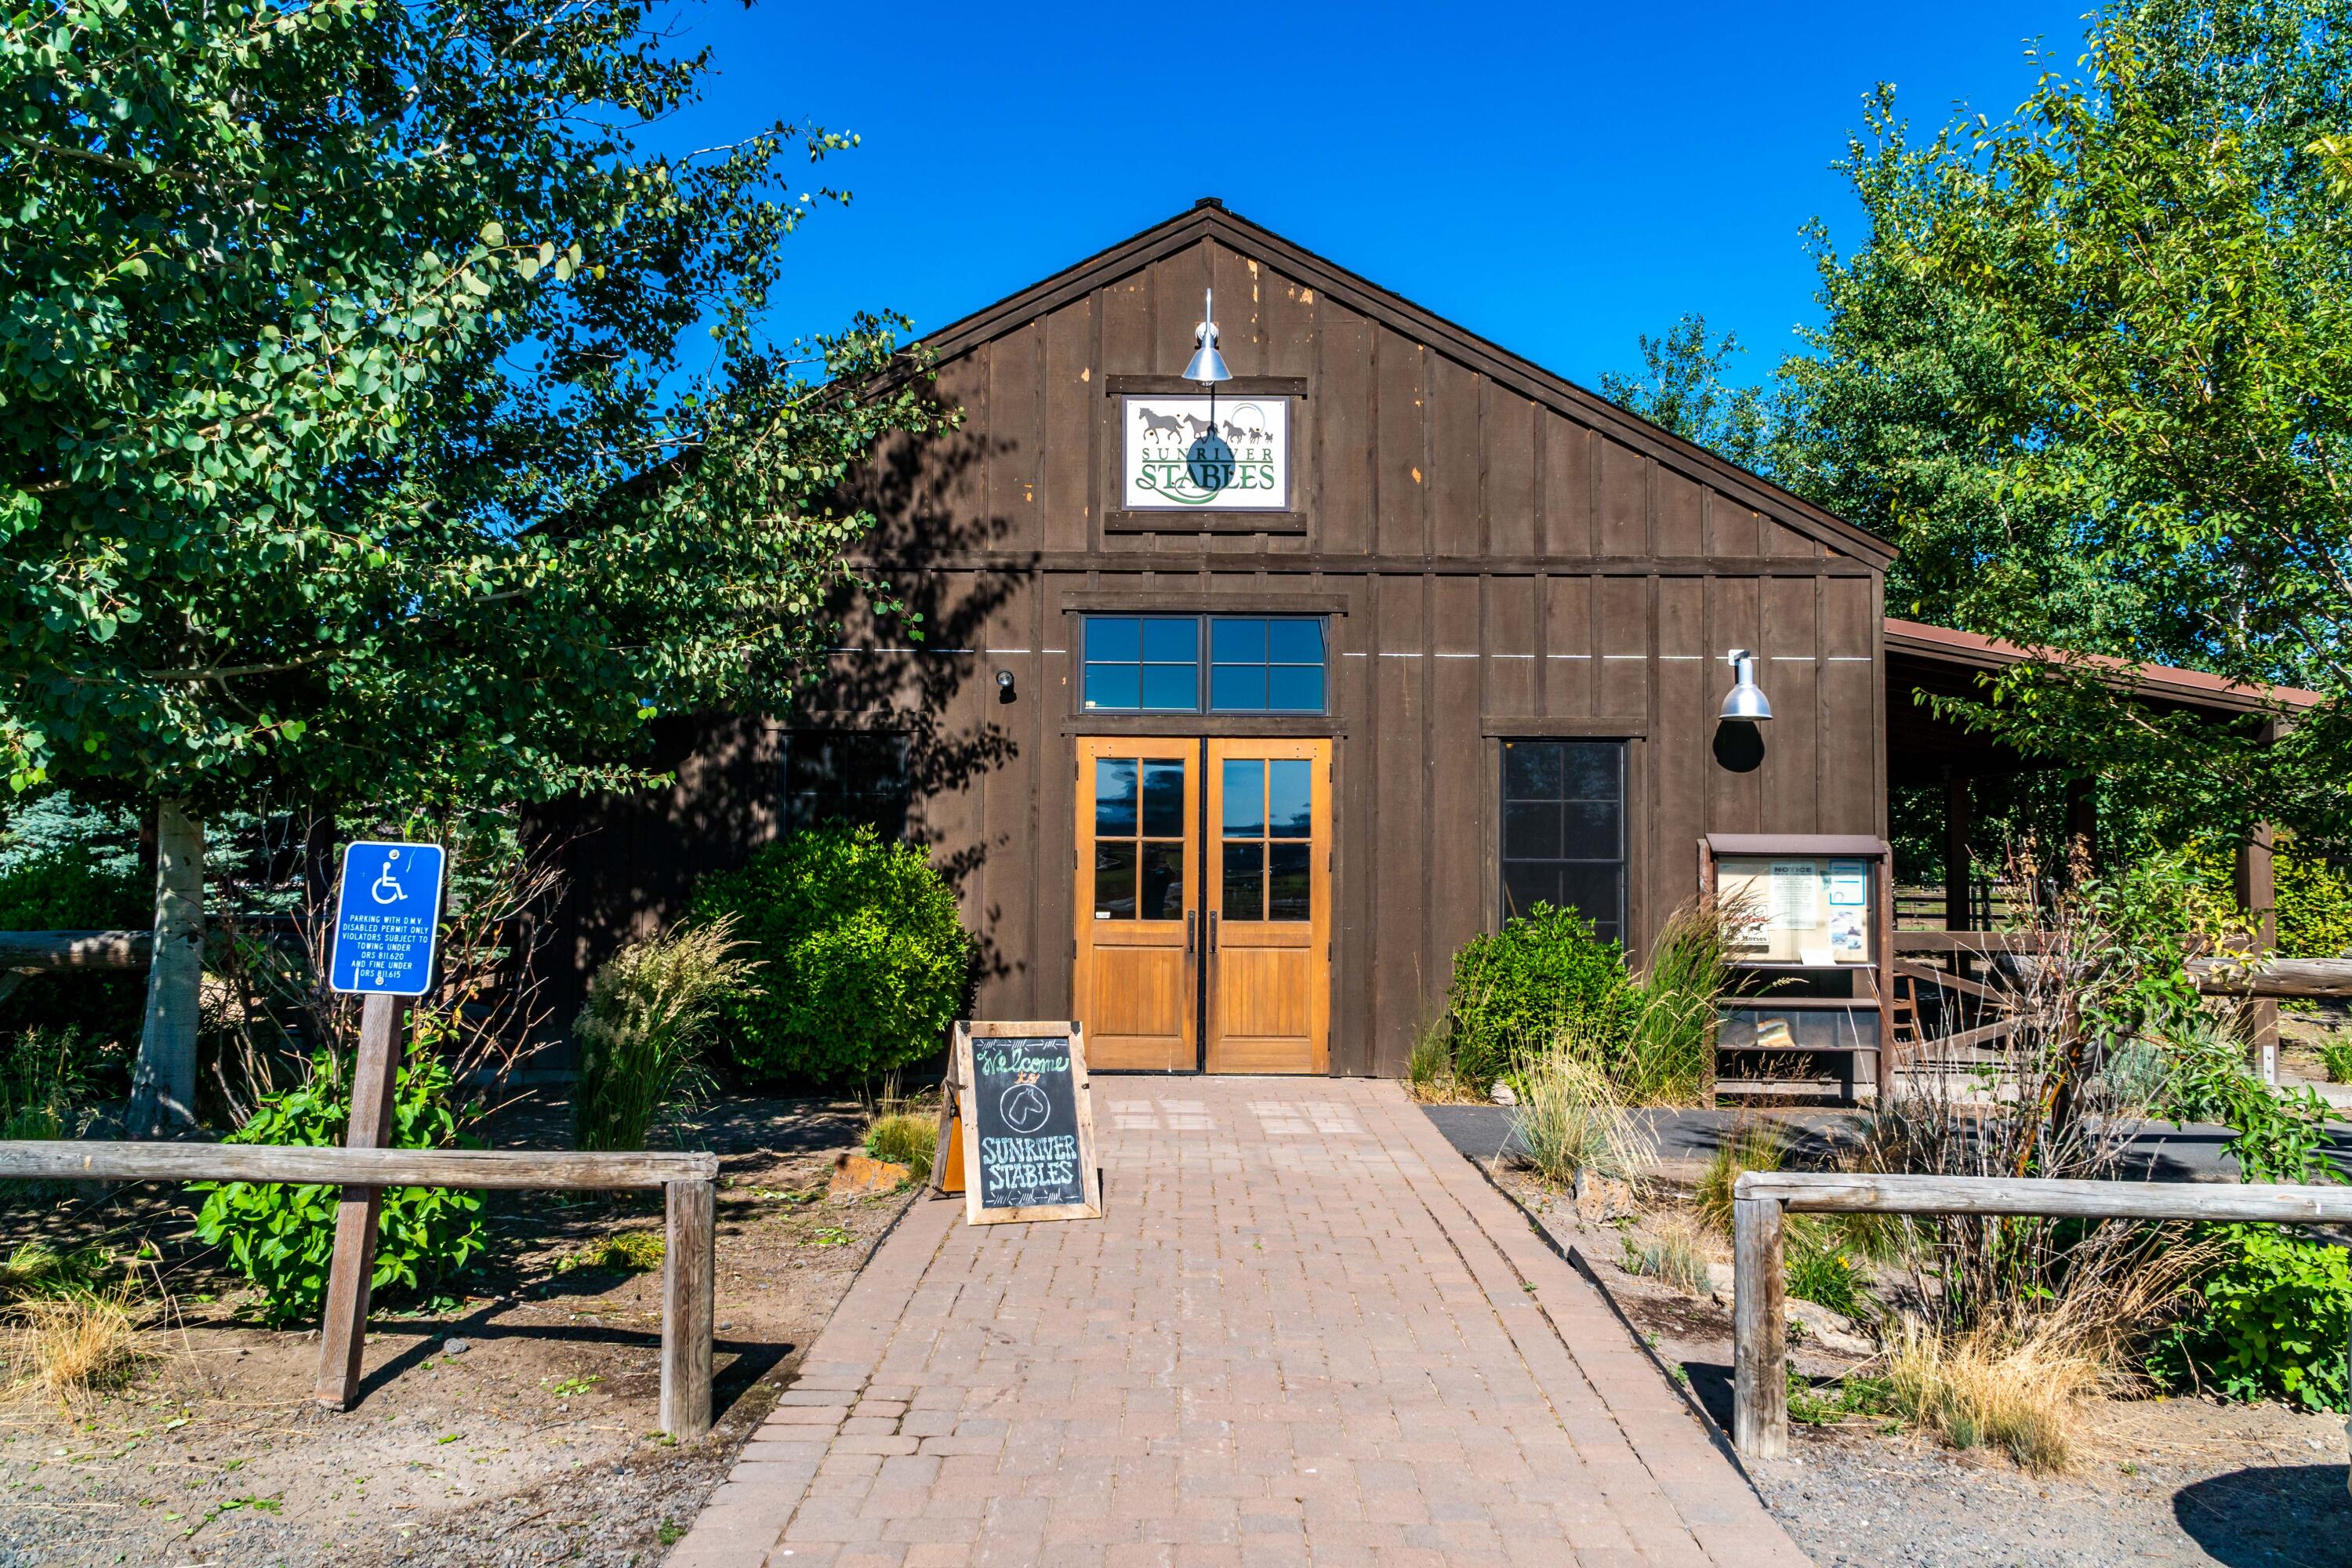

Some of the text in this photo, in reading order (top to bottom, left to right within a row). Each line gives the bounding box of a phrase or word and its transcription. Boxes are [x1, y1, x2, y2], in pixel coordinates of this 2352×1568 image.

[1142, 448, 1273, 460] SUNRIVER
[1136, 464, 1275, 492] STABLES
[977, 1048, 1069, 1075] Welcome
[982, 1134, 1077, 1164] SUNRIVER
[989, 1160, 1073, 1190] STABLES
